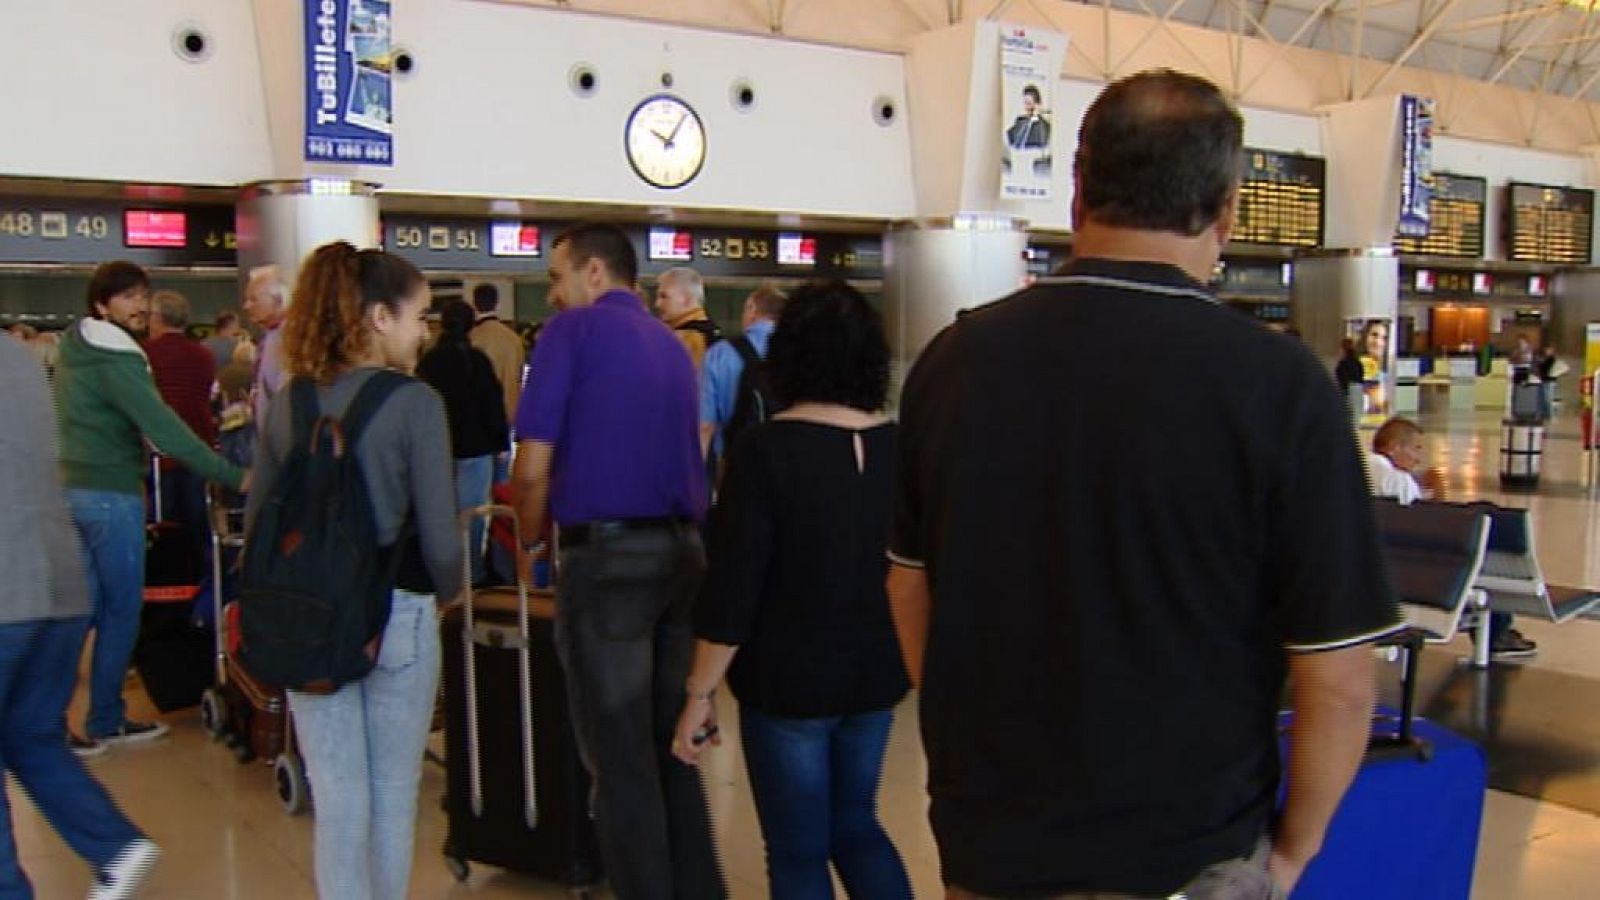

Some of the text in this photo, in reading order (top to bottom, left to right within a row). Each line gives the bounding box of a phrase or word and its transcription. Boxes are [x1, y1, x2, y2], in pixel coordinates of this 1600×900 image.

[0, 213, 33, 236] 48
[75, 216, 108, 239] 49
[396, 227, 421, 246] 50
[456, 230, 479, 249] 51
[701, 239, 722, 256] 52
[747, 241, 768, 258] 53
